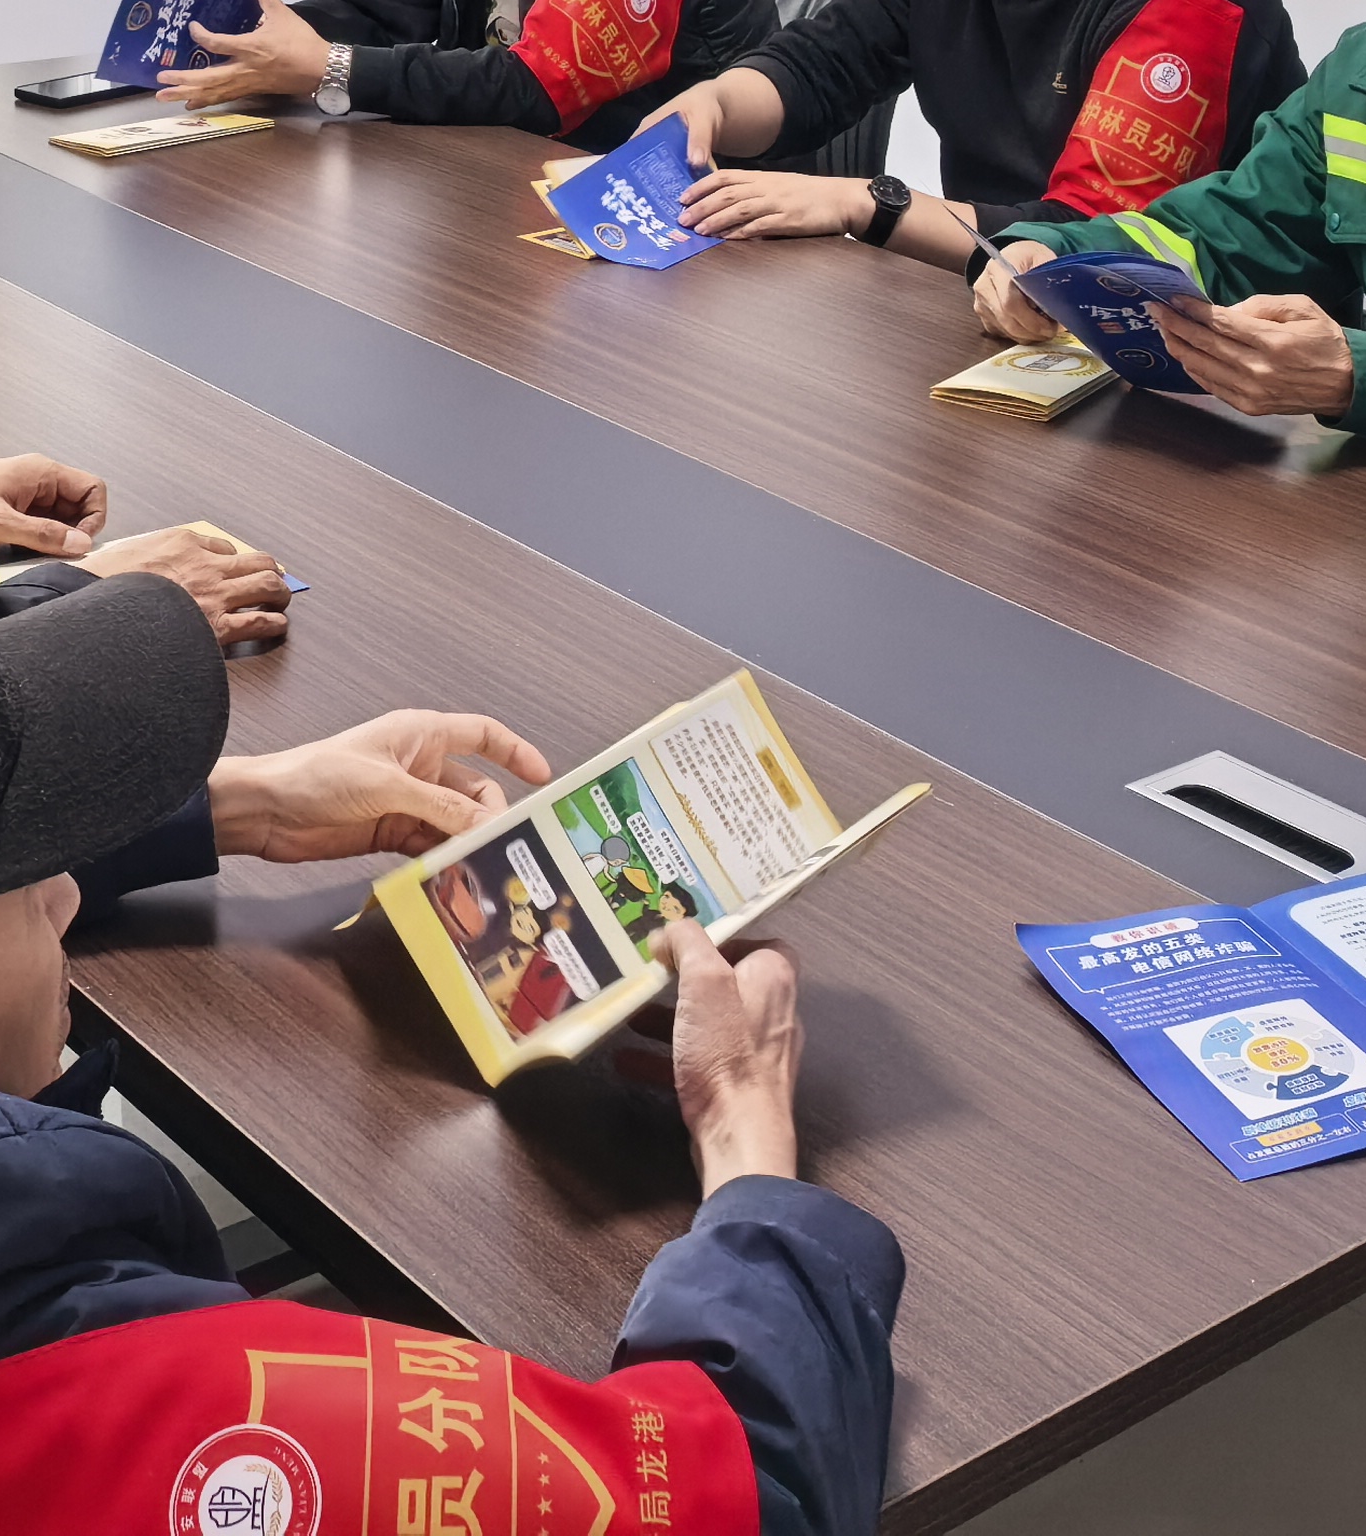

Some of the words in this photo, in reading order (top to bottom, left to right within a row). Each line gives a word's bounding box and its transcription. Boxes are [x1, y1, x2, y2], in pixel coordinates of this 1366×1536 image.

[1078, 932, 1206, 971] 最高发的五类
[1130, 939, 1259, 976] 电信网络诈骗
[630, 1398, 672, 1528] 局龙港
